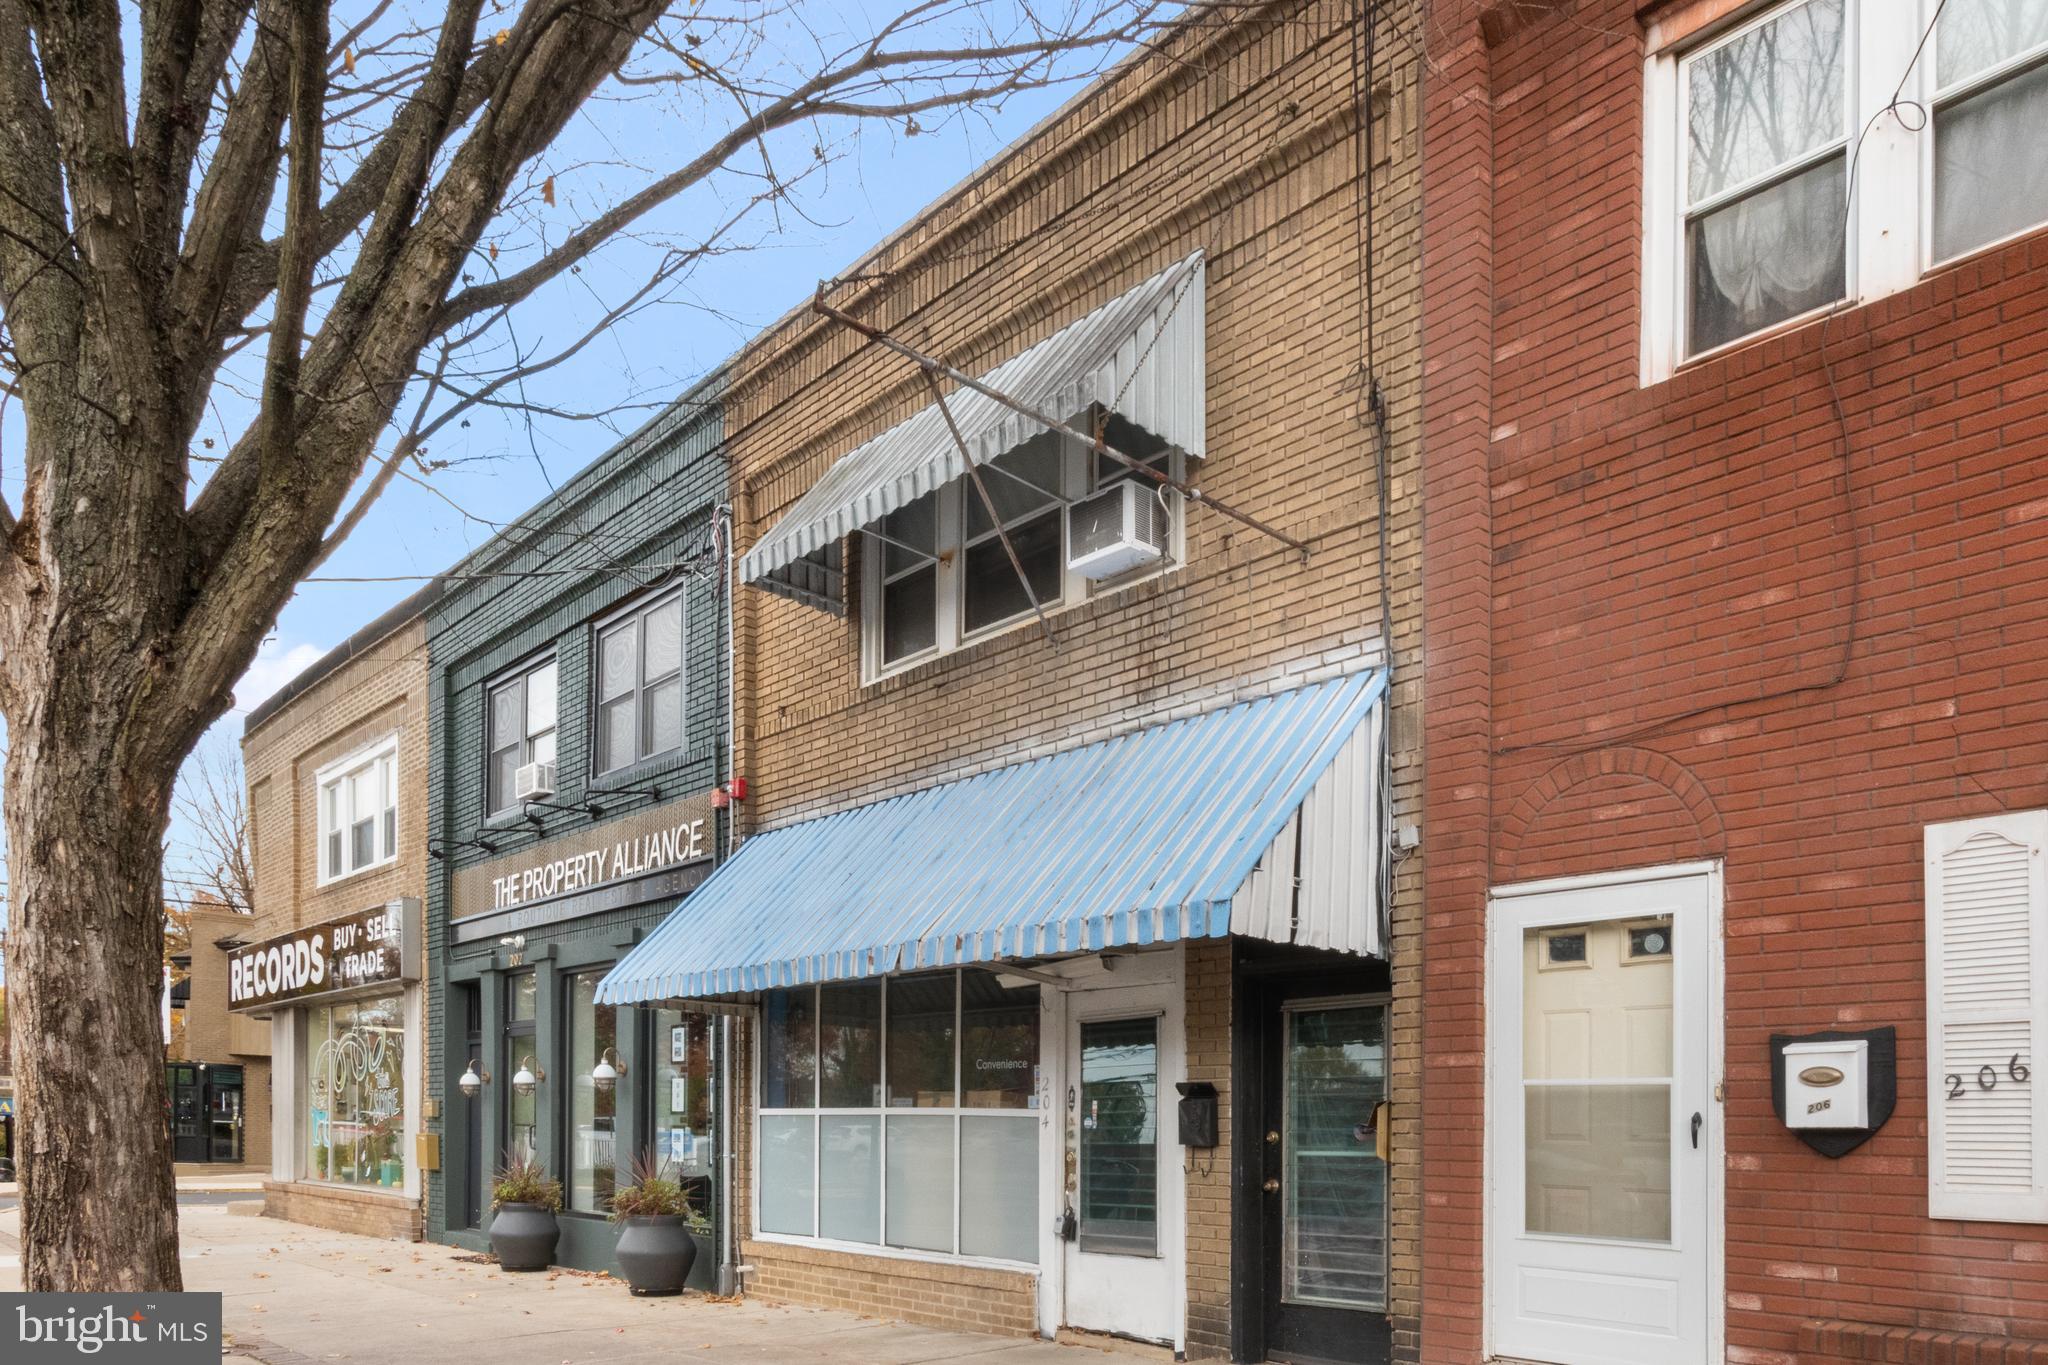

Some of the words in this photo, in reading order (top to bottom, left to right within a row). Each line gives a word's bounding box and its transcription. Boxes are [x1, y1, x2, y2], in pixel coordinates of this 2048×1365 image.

[493, 872, 520, 910] THE
[522, 847, 608, 901] PROPERTY
[611, 819, 704, 880] ALLIANCE
[333, 922, 357, 951] BUY
[366, 913, 397, 942] SELL
[231, 934, 325, 1002] RECORDS
[344, 947, 385, 979] TRADE
[975, 1058, 1028, 1071] Convenience
[1944, 1053, 2030, 1101] 206
[1041, 1076, 1051, 1129] 204
[1807, 1099, 1832, 1116] 206
